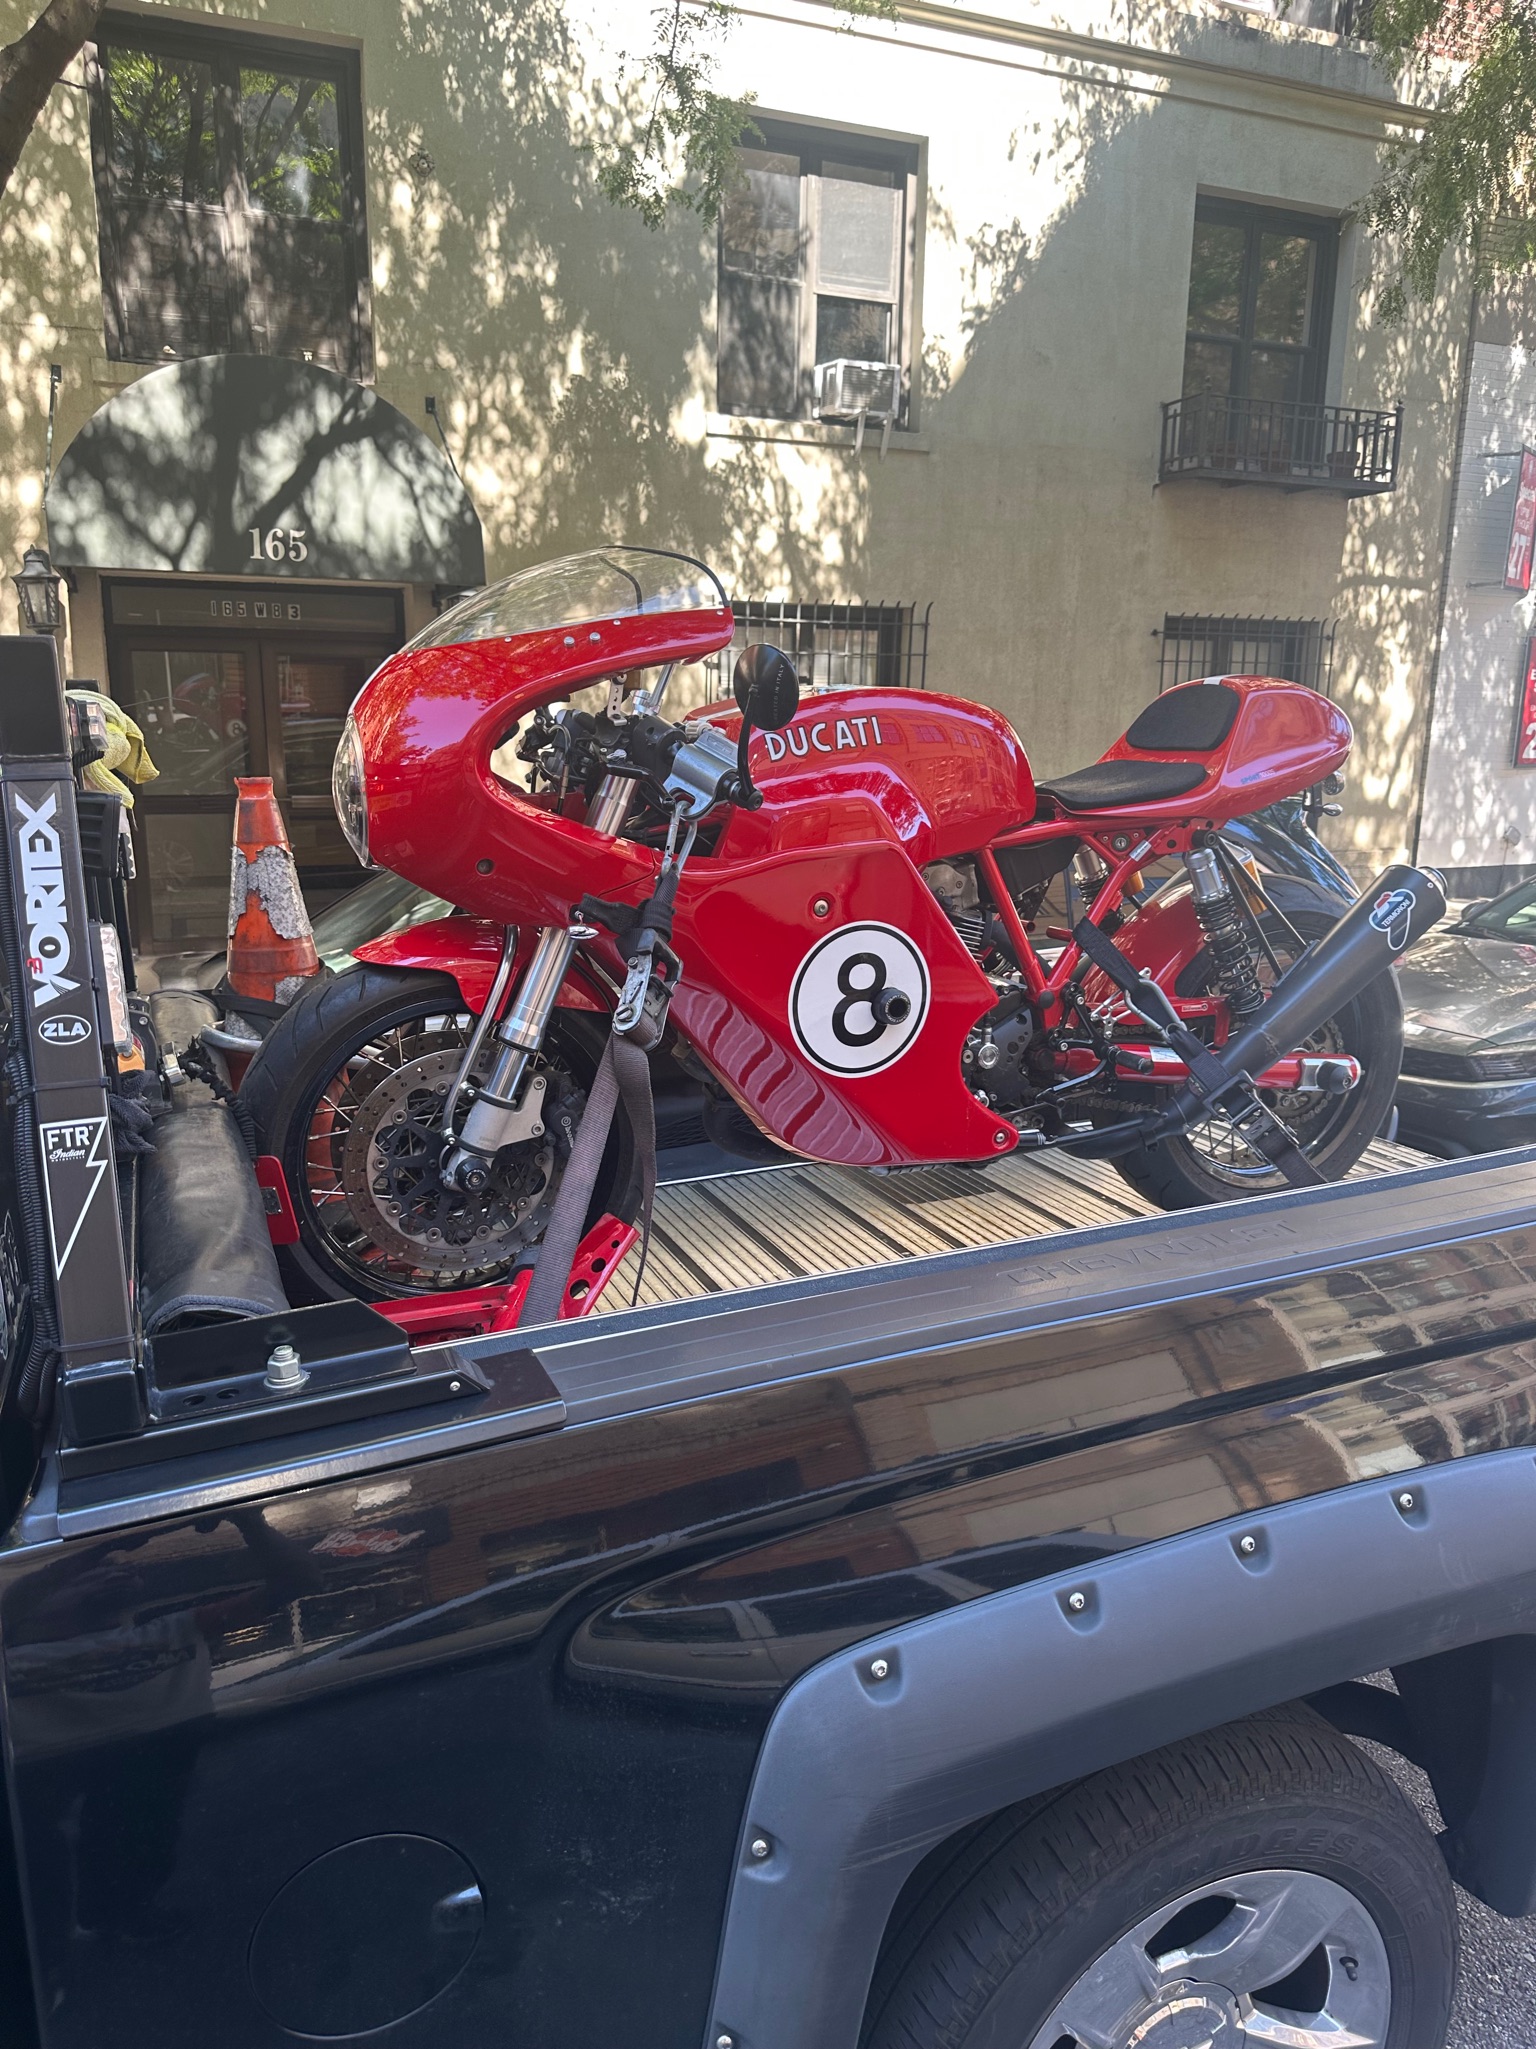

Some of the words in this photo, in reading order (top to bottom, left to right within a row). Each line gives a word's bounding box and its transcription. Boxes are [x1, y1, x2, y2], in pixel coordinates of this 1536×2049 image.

[249, 527, 308, 562] 165
[764, 716, 883, 762] DUCATI
[15, 793, 81, 1008] VORTEX
[1381, 898, 1411, 927] TERMIGNONI
[832, 952, 888, 1047] 8
[43, 1022, 86, 1038] ZLA
[47, 1126, 90, 1149] FTR
[49, 1148, 85, 1159] Indian
